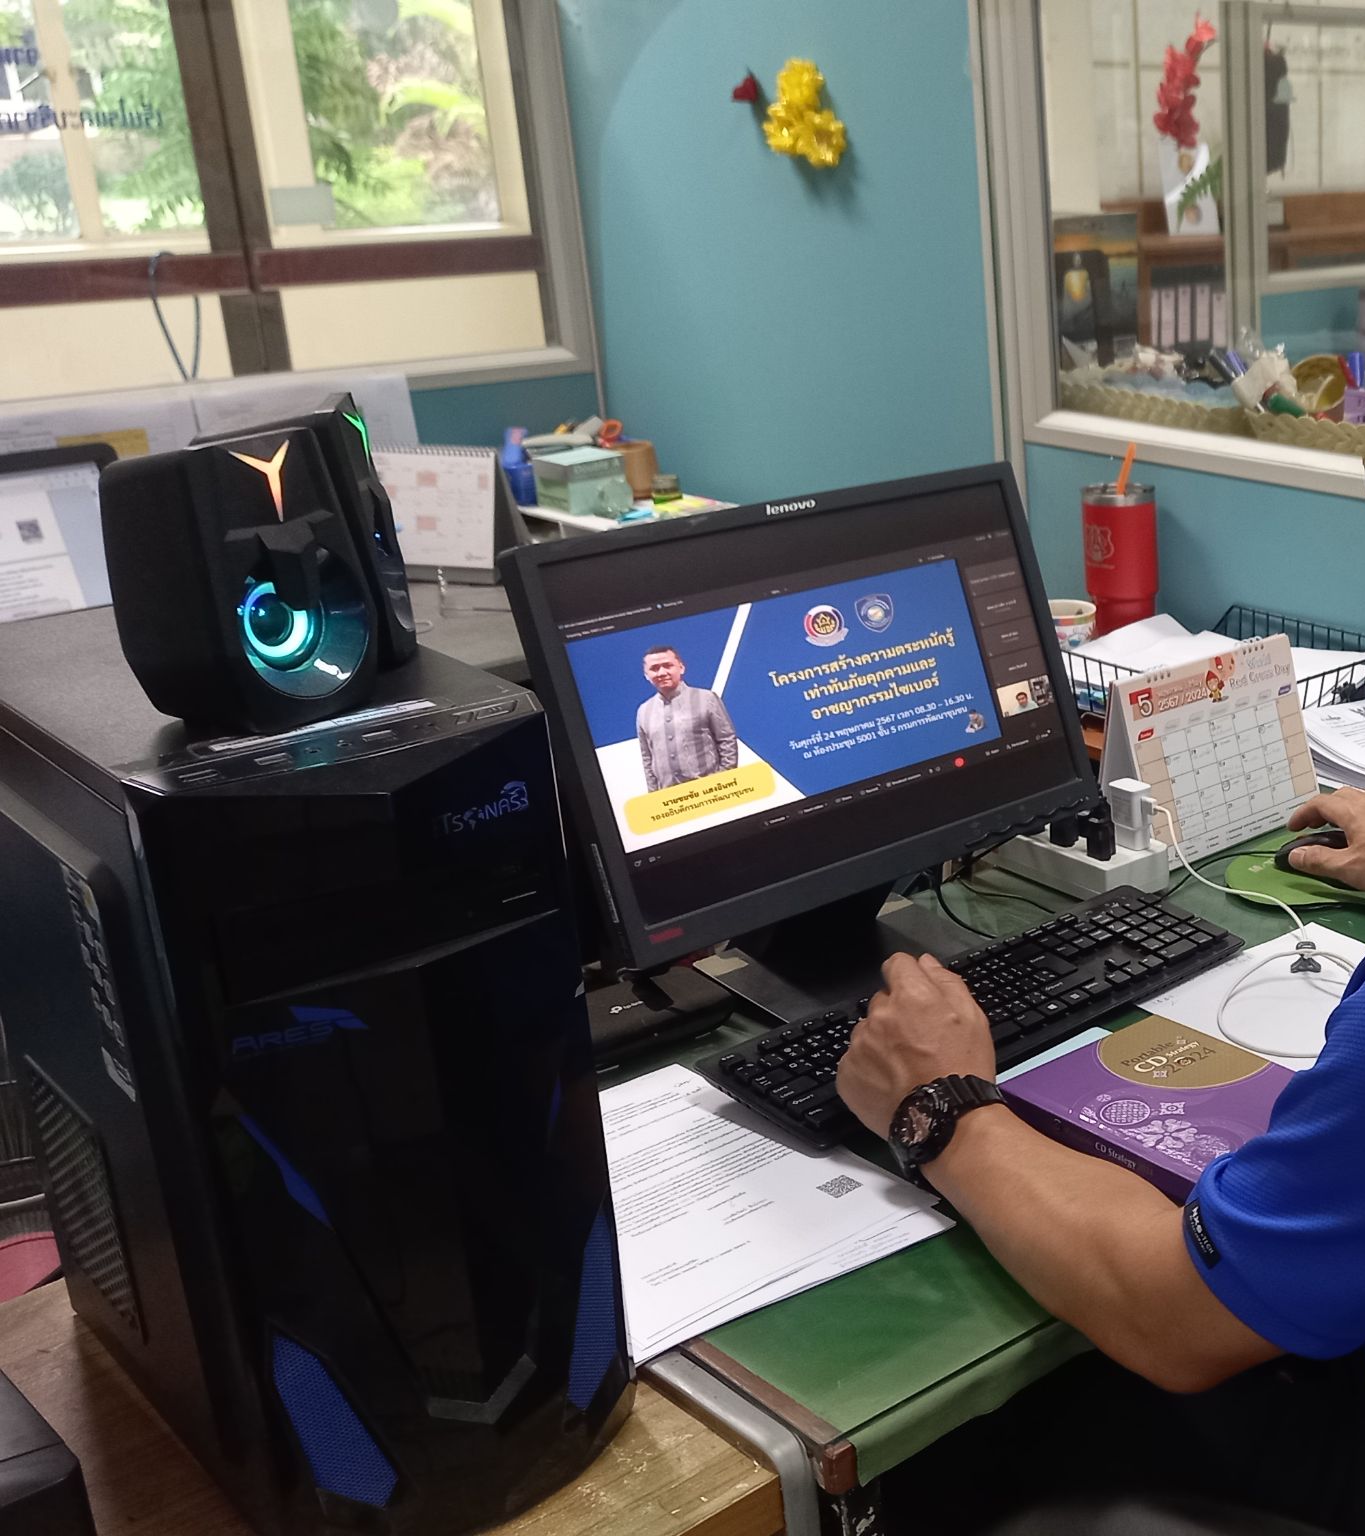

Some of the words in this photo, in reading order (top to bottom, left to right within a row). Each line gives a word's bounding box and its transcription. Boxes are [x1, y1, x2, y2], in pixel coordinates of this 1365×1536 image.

[765, 498, 816, 516] lenovo
[768, 627, 956, 688] โครงการสร้างความตระหนักรู้
[803, 657, 937, 702] เท่าทันภัยคุกคามและ
[811, 671, 940, 720] อาชญากรรมไซเบอร์
[1138, 692, 1154, 718] 5
[1158, 696, 1179, 713] 2567
[1186, 687, 1209, 703] 2024
[876, 713, 896, 729] 2567
[857, 732, 877, 746] 5001
[232, 1020, 334, 1055] ARES
[1121, 1040, 1174, 1067] Portable
[1134, 1055, 1168, 1073] CD
[1165, 1040, 1200, 1058] Strategy
[1095, 1141, 1107, 1153] CD
[1108, 1147, 1137, 1170] Strategy
